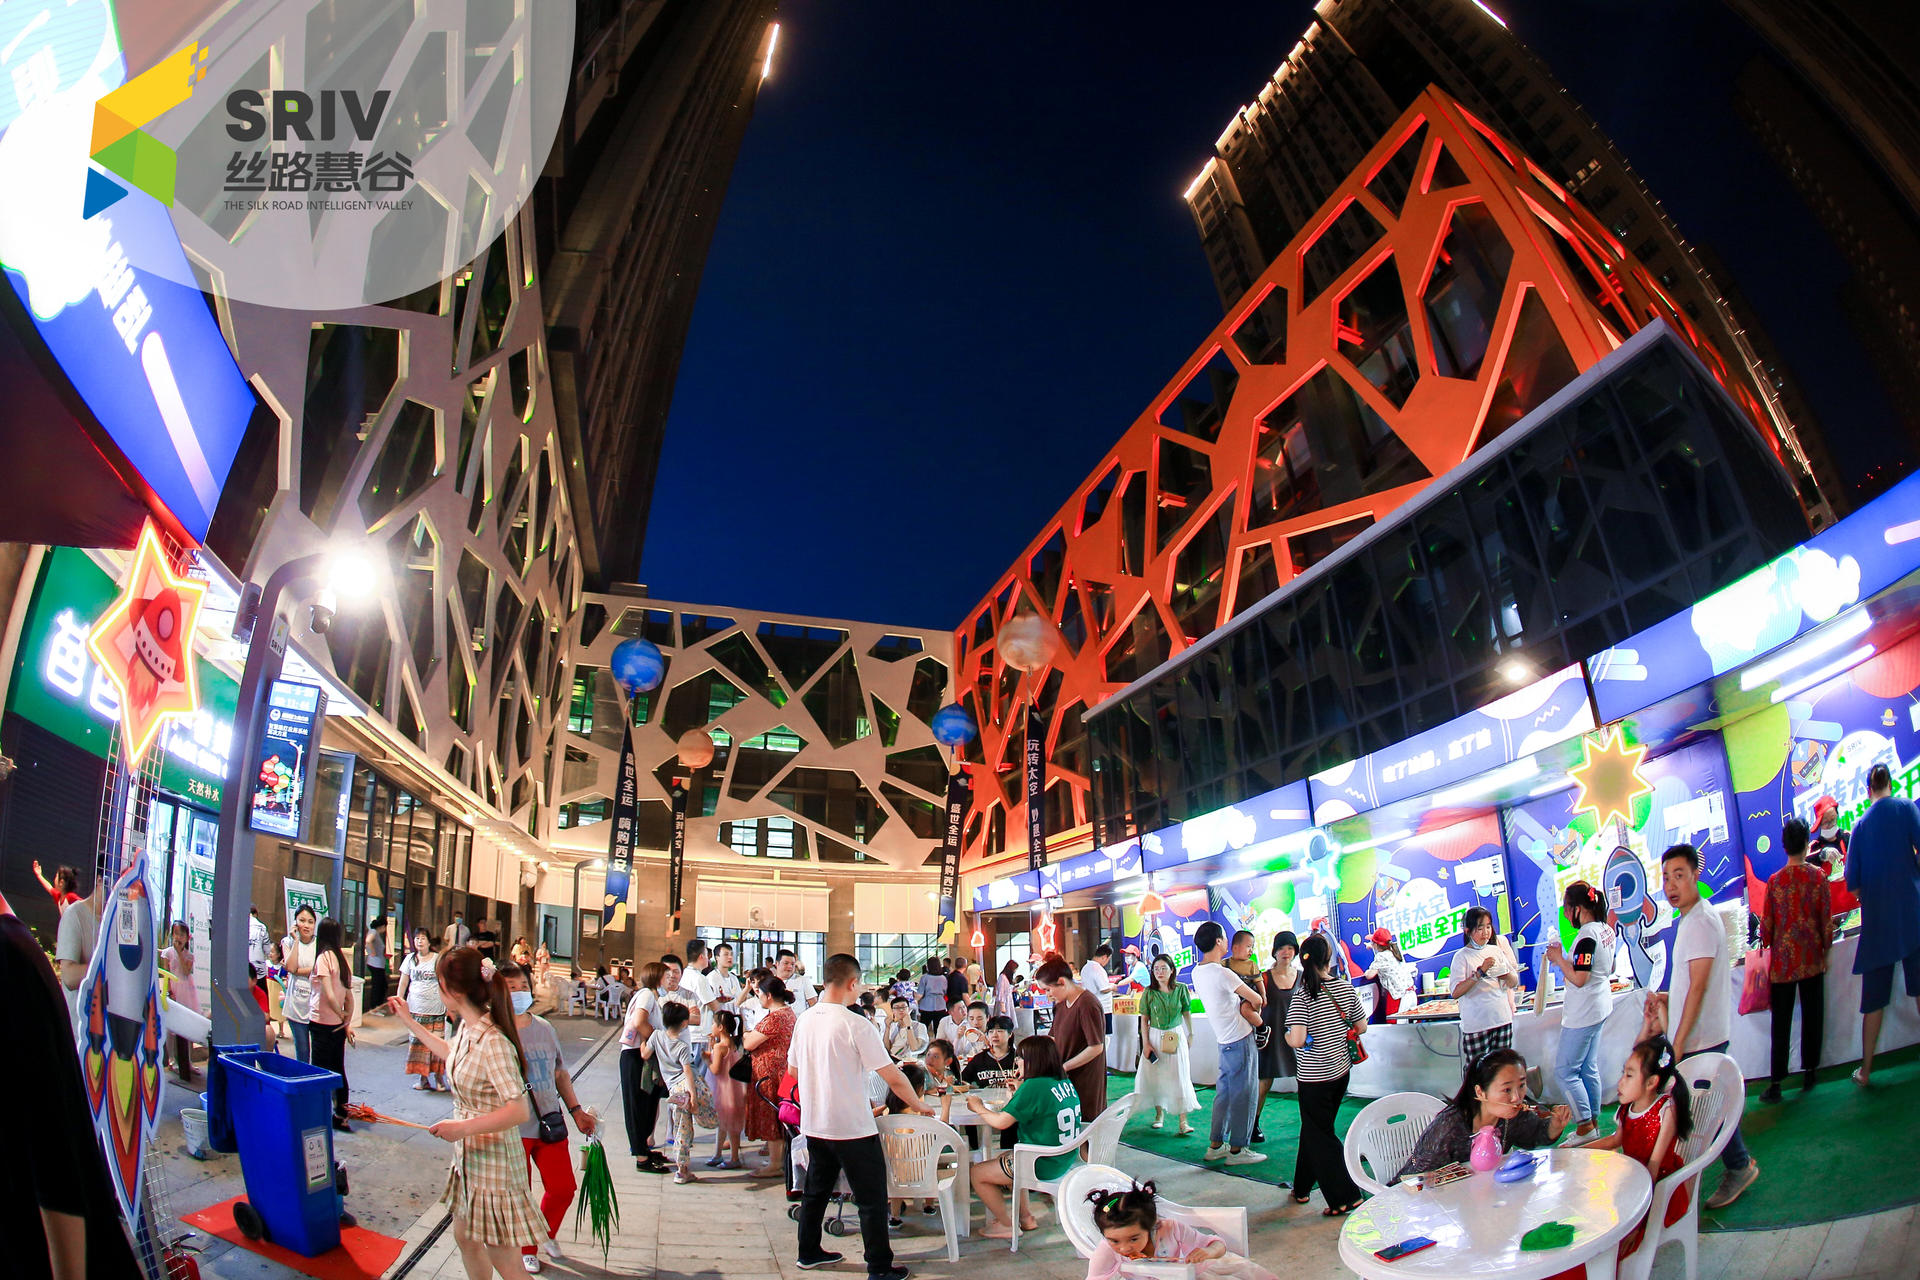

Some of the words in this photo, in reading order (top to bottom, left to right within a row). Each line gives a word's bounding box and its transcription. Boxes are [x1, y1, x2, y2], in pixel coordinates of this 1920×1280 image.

[187, 778, 220, 802] 天然补水
[620, 752, 635, 807] 盛世全运
[1026, 739, 1040, 797] 玩转太空
[613, 817, 632, 872] 嗨购西安
[947, 803, 961, 847] 盛世全运
[942, 854, 956, 898] 嗨购西安
[1379, 893, 1447, 932] 玩转太空
[1399, 907, 1467, 951] 妙趣全开
[1051, 1081, 1077, 1103] BAPE
